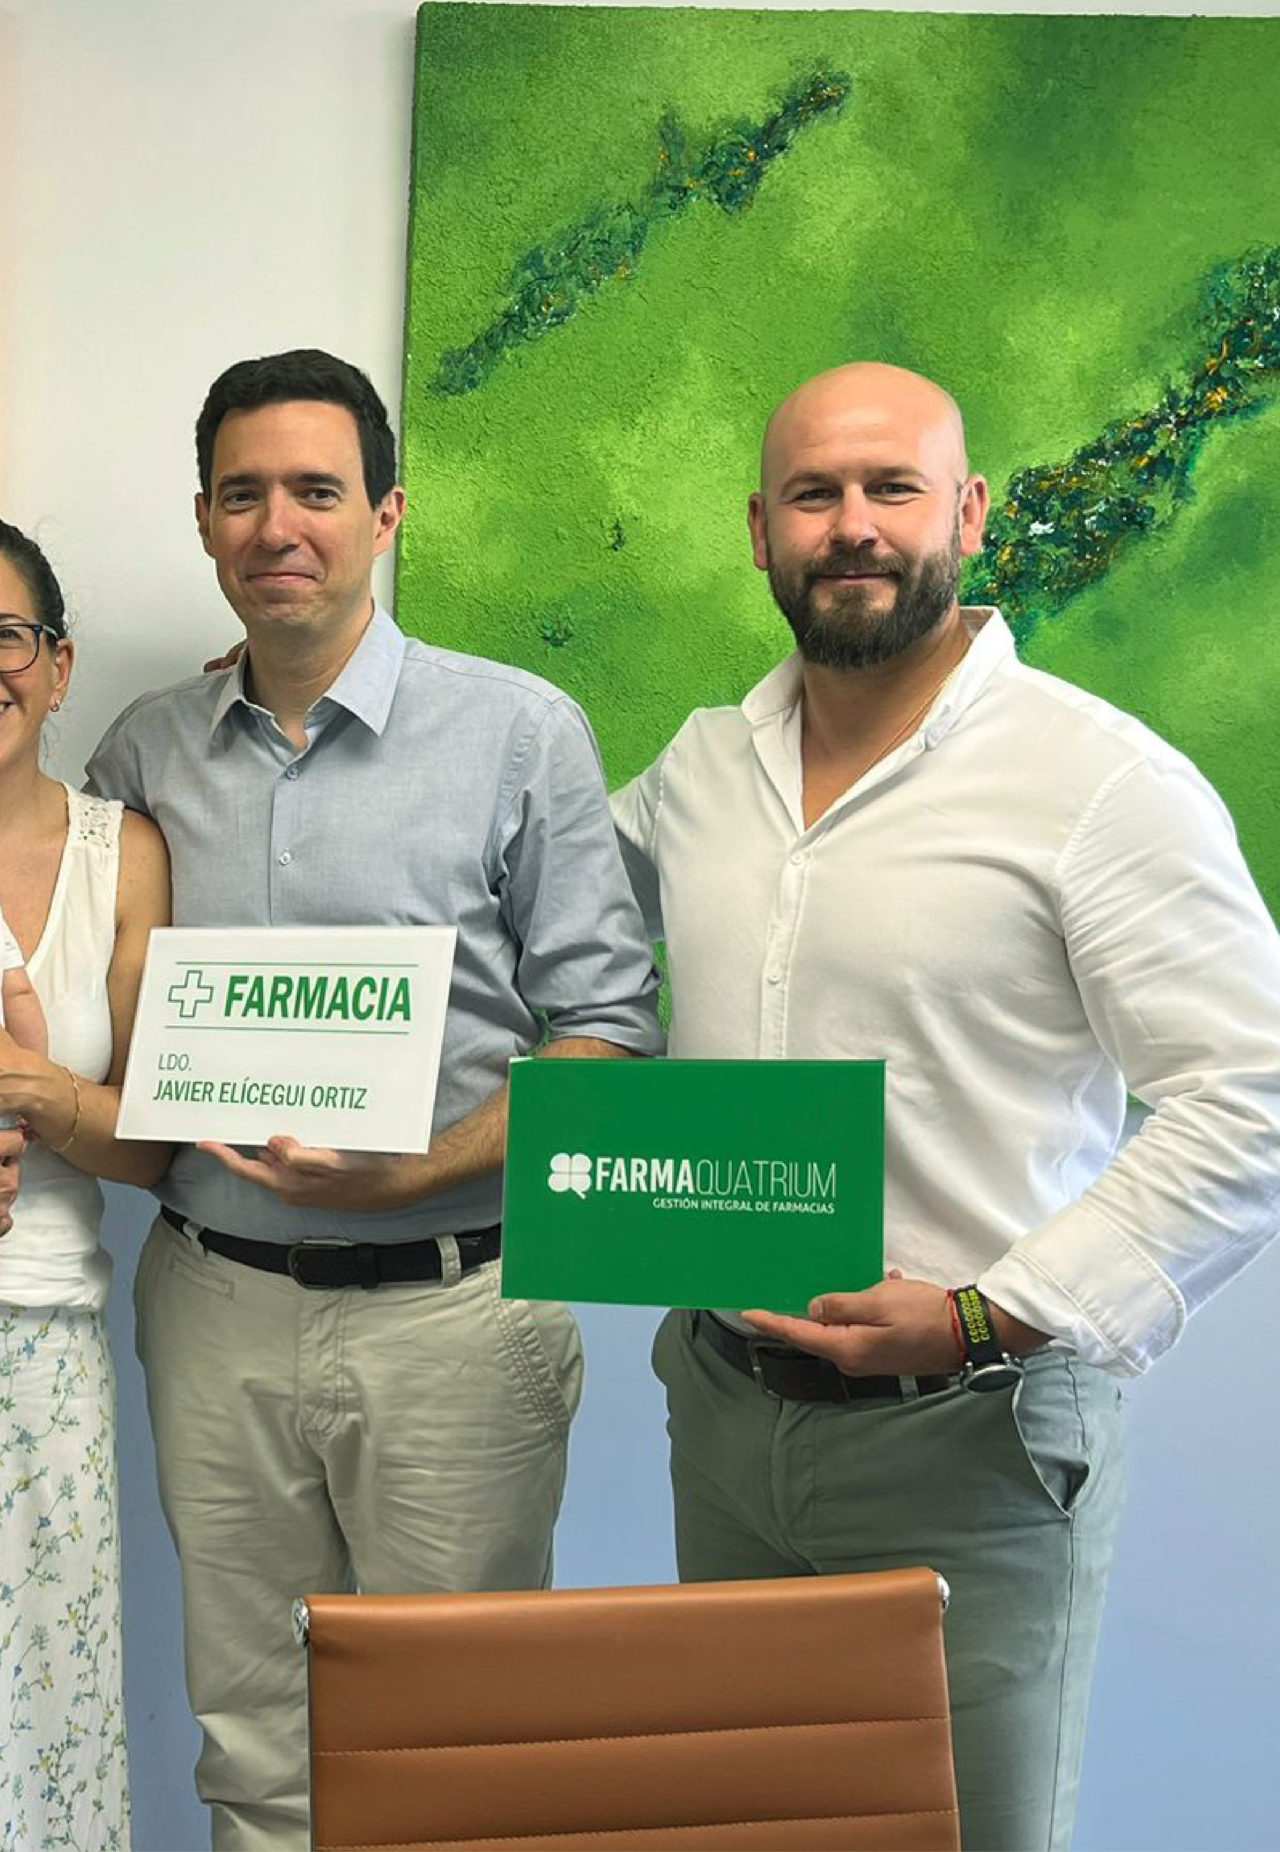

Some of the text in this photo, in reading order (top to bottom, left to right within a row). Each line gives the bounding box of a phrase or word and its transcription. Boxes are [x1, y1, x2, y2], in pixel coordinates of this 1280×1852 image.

[223, 974, 413, 1022] FARMACIA
[157, 1053, 193, 1072] LDO.
[152, 1076, 368, 1110] JAVIER ELÍCEGUI ORTIZ
[595, 1157, 837, 1198] FARMAQUATRIUM
[652, 1197, 836, 1215] GESTIÓN INTEGRAL DE FARMACIAS
